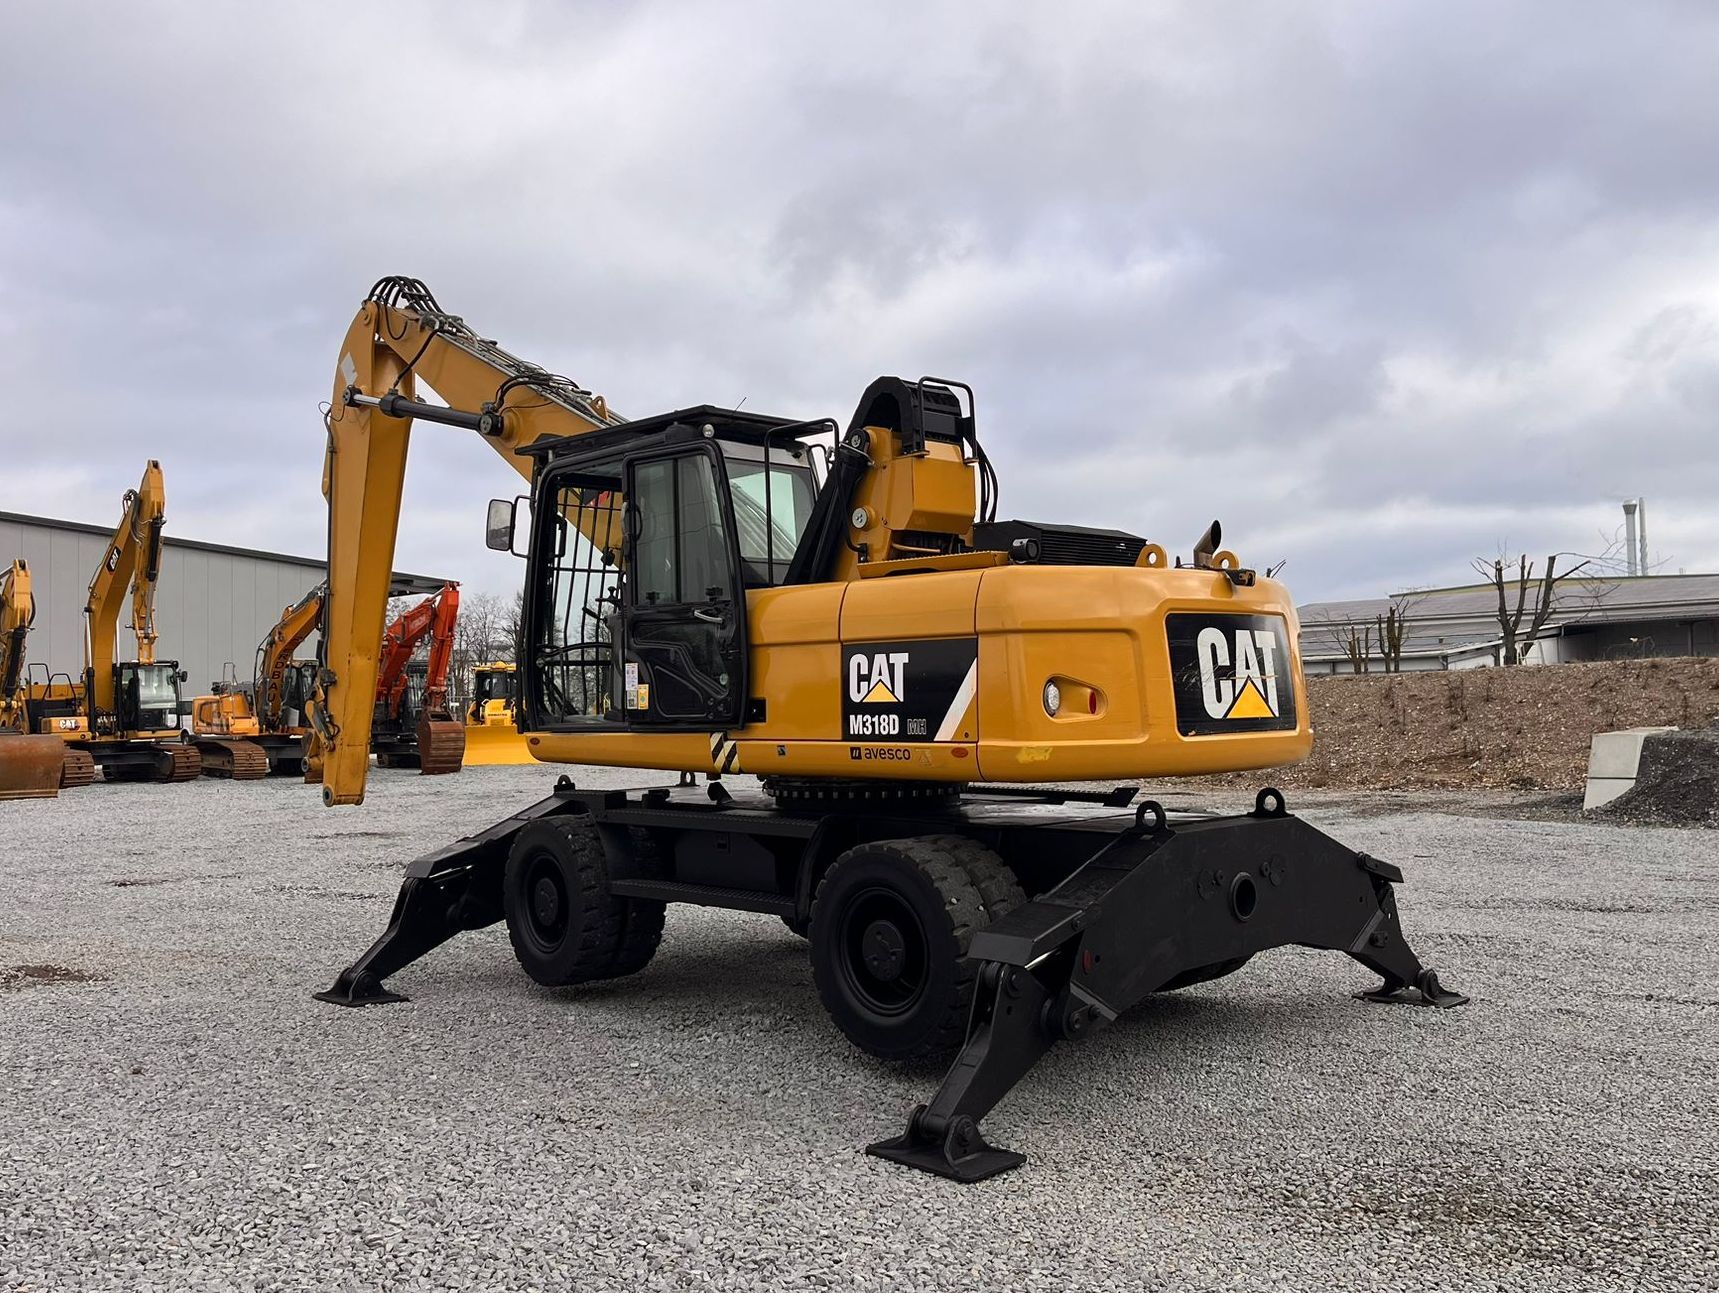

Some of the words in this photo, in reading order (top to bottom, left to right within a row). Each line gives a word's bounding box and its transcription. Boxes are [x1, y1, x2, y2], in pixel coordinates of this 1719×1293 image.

[849, 652, 909, 703] CAT
[1197, 627, 1279, 719] CAT
[59, 719, 76, 729] CAT
[849, 714, 900, 735] M318D
[907, 718, 927, 735] MH
[864, 748, 911, 760] avesco
